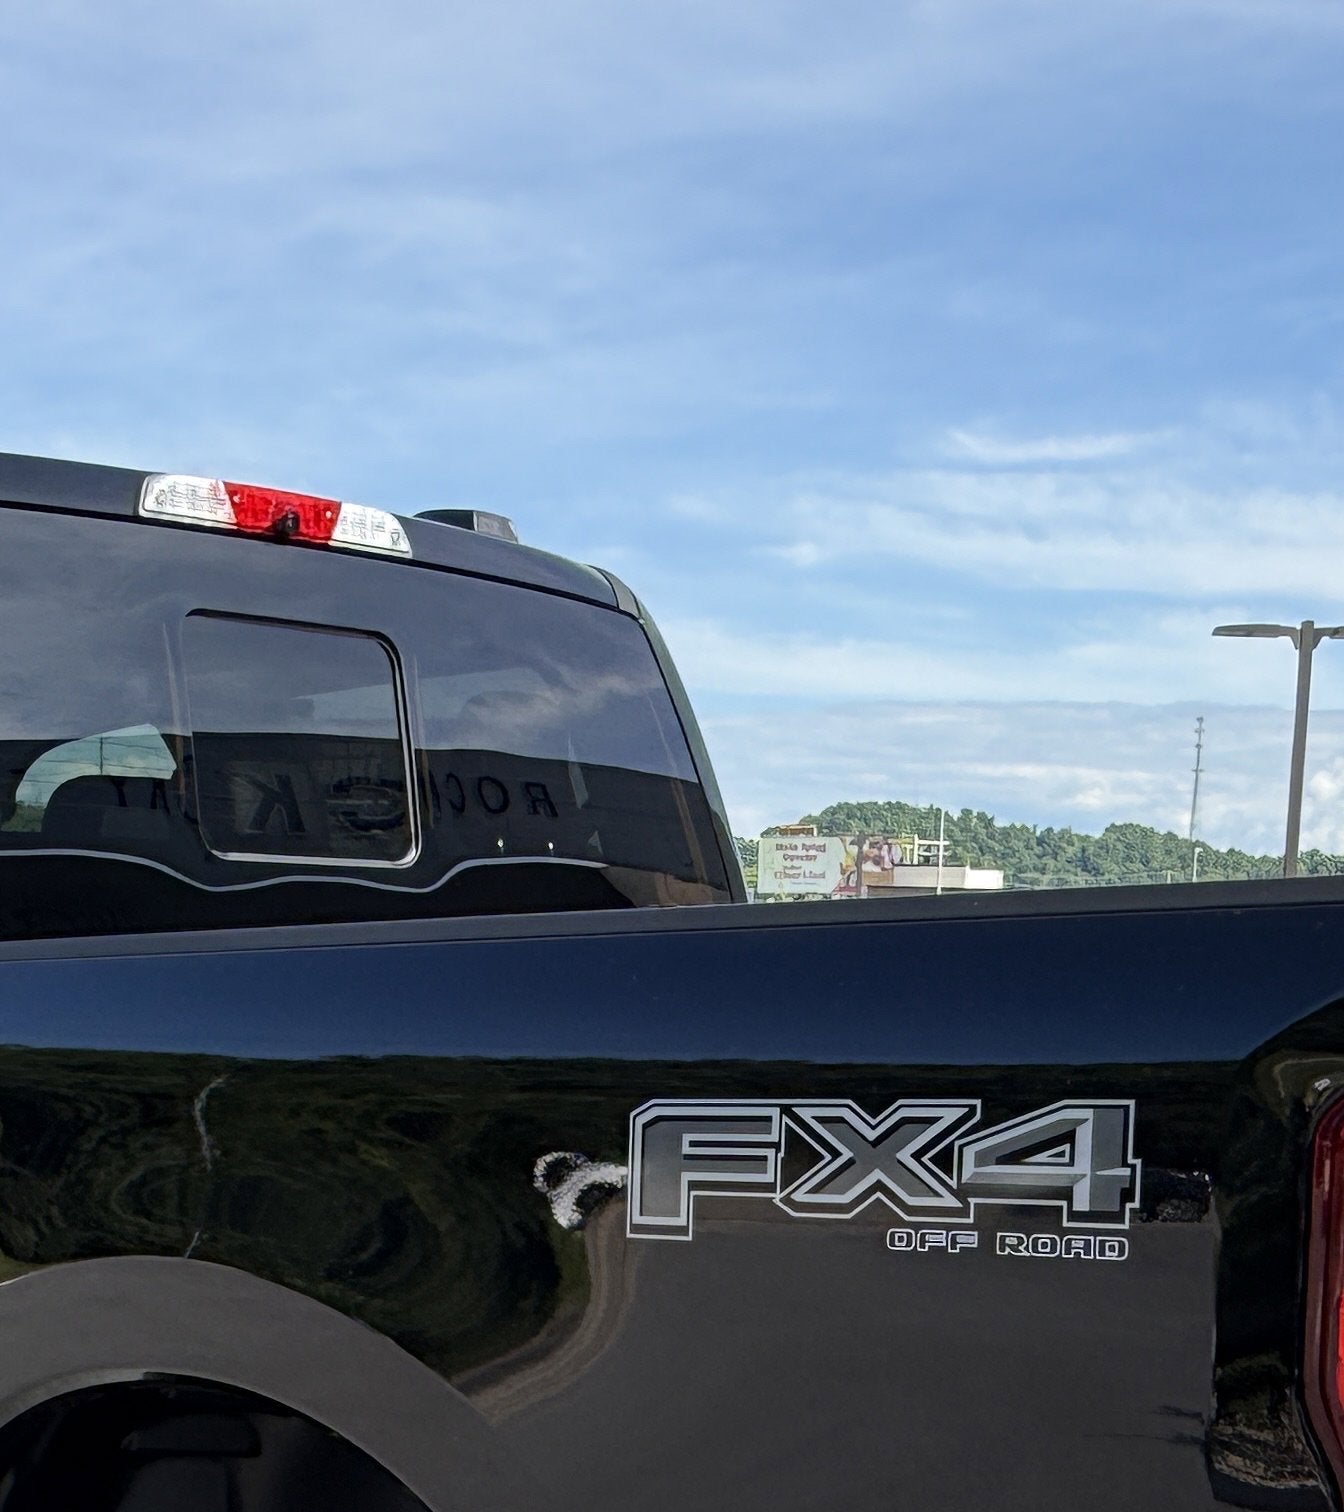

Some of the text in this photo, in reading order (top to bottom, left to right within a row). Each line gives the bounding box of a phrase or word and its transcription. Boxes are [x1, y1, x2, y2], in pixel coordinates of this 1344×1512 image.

[627, 1099, 1142, 1240] FX4
[886, 1228, 1129, 1261] OFF ROAD
